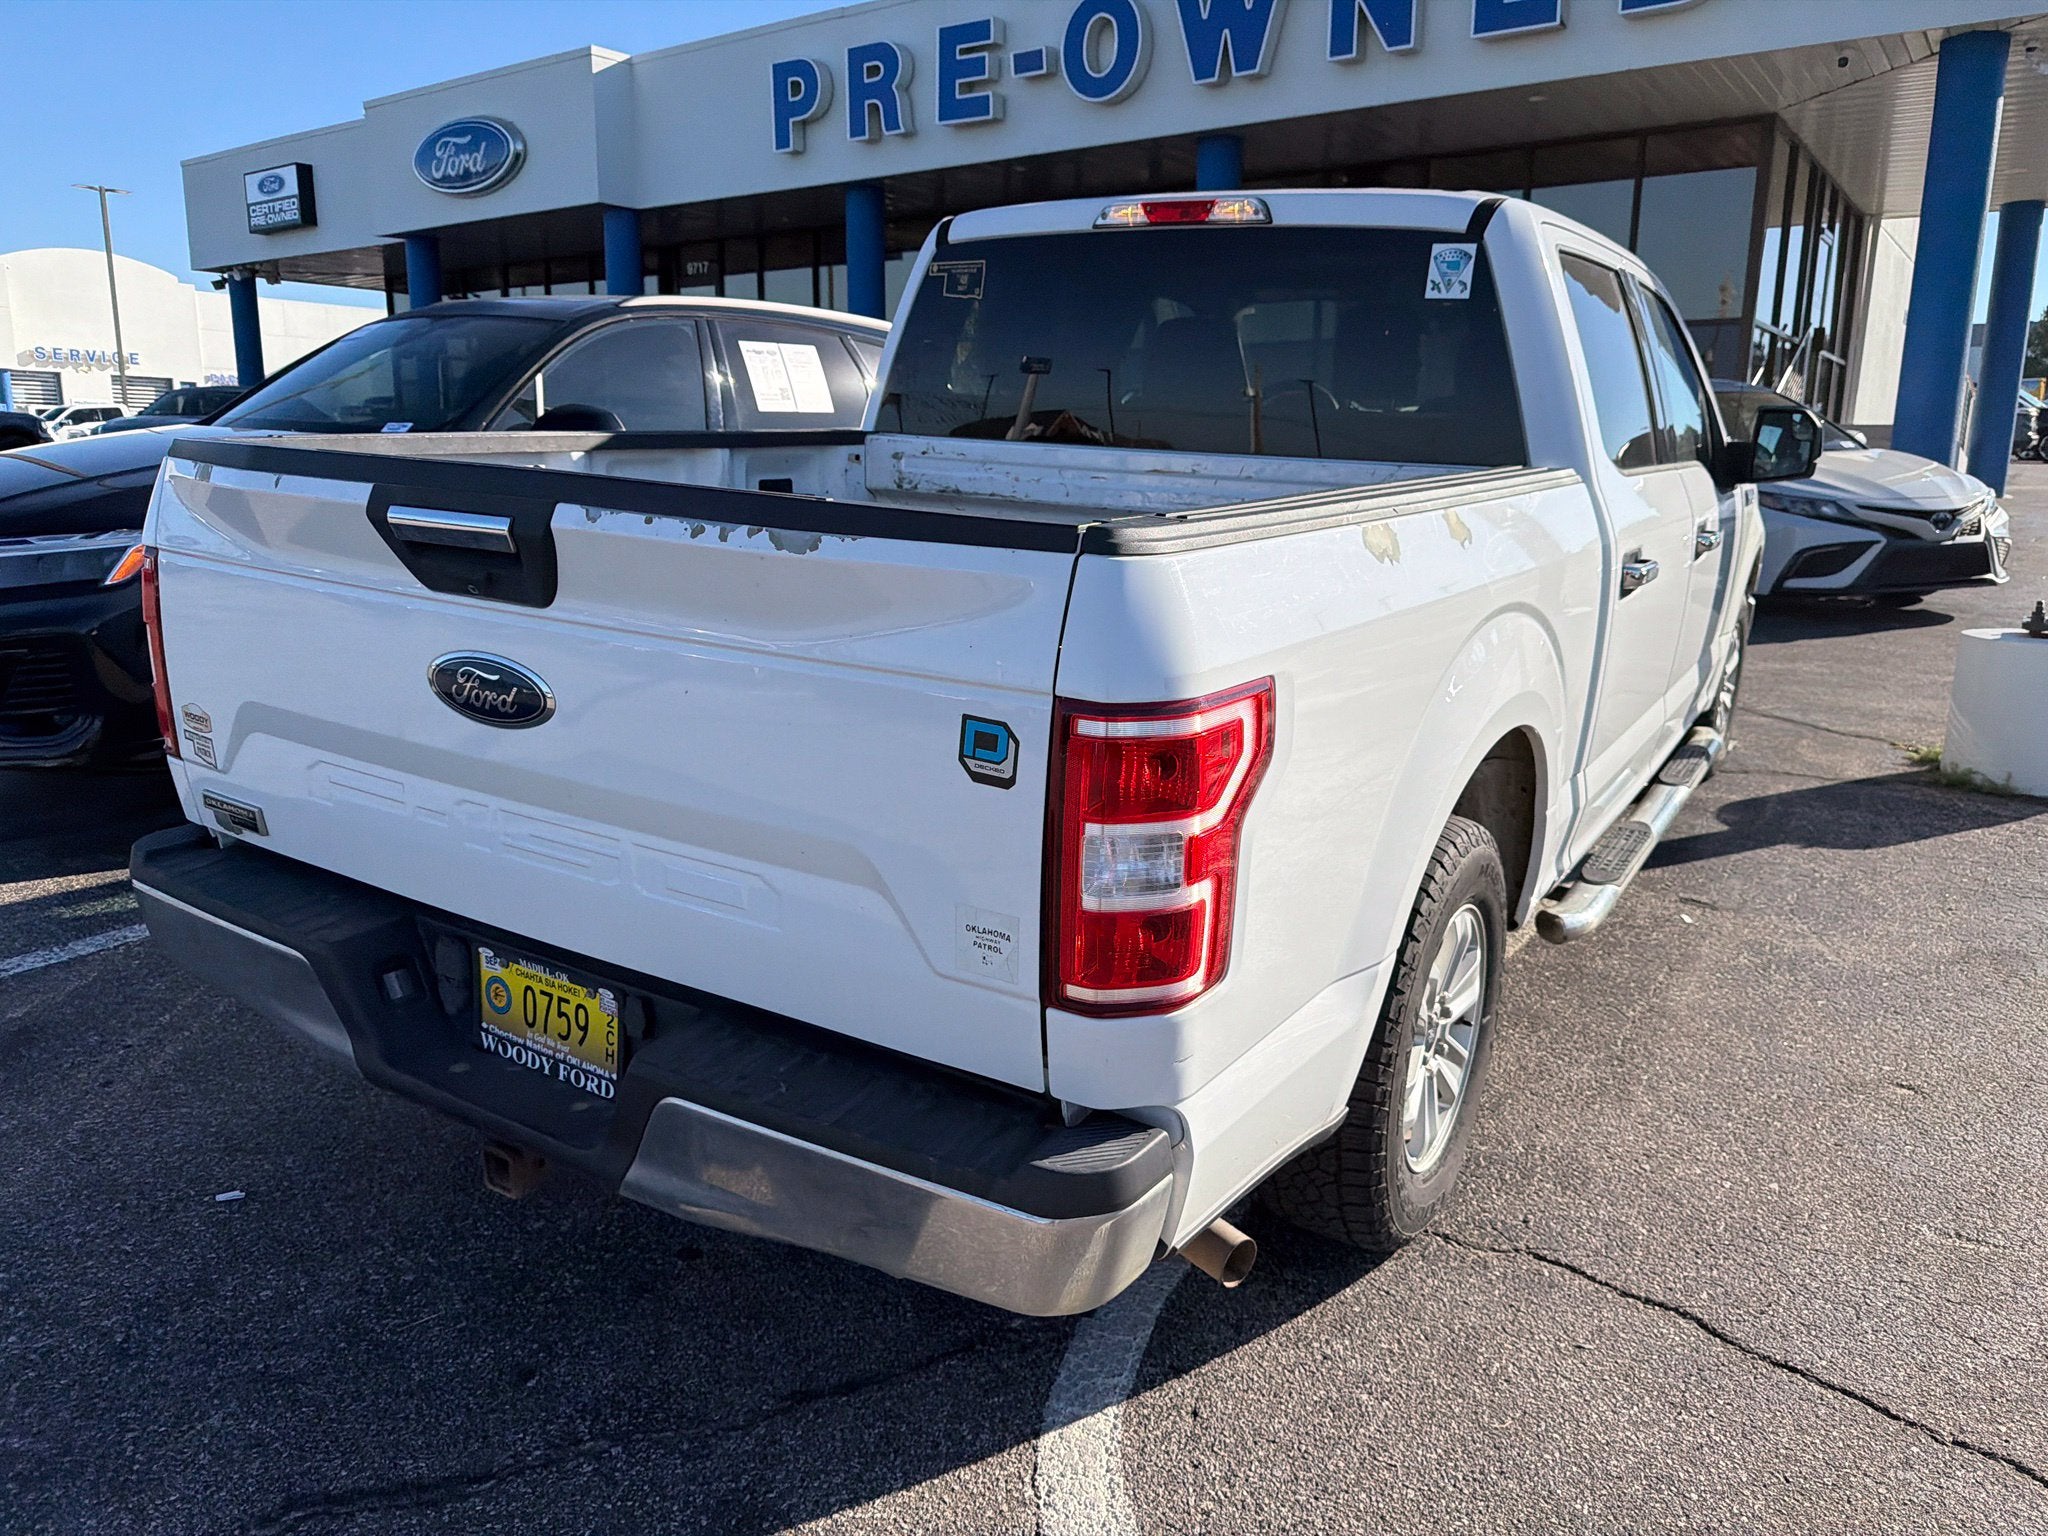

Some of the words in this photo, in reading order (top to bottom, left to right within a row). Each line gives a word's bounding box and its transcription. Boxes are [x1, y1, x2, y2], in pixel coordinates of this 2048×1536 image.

[770, 0, 1698, 152] PRE-OW
[432, 134, 486, 179] Ford
[249, 198, 298, 217] CERTIFIED
[250, 209, 299, 227] PRE-OWNED
[451, 666, 517, 713] Ford
[205, 798, 255, 819] OKLAHOMA
[965, 924, 1011, 943] OKLAHOMA
[973, 940, 1004, 955] PATROL
[555, 971, 571, 983] OK
[523, 985, 589, 1047] 0759
[480, 1031, 554, 1075] WOODY
[558, 1062, 616, 1099] FORD
[489, 1024, 525, 1045] Choctaw
[526, 1038, 554, 1057] Nation
[566, 1054, 611, 1079] OKLAHOMA
